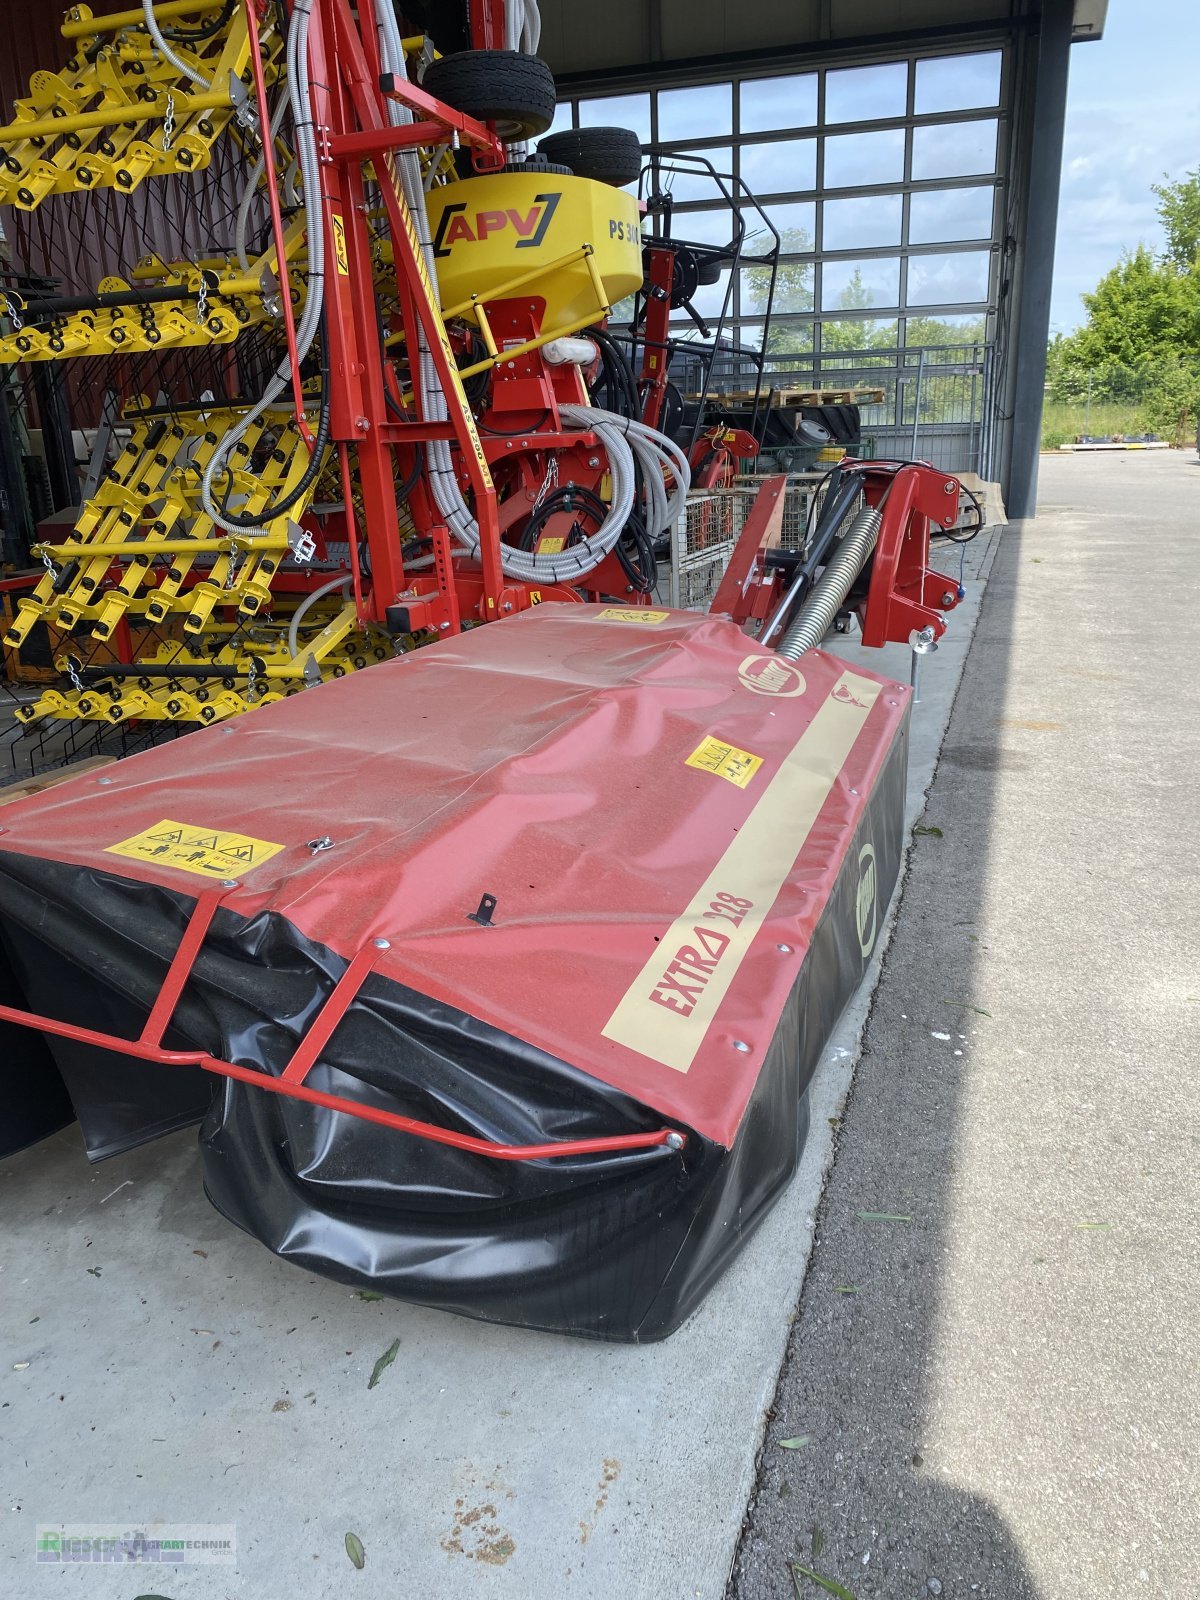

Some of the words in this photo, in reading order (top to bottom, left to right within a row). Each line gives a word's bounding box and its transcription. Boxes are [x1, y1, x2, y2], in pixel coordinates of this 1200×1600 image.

[609, 219, 625, 241] PS
[213, 855, 240, 866] STOP
[648, 926, 731, 1018] EXTRA
[702, 891, 754, 929] 228
